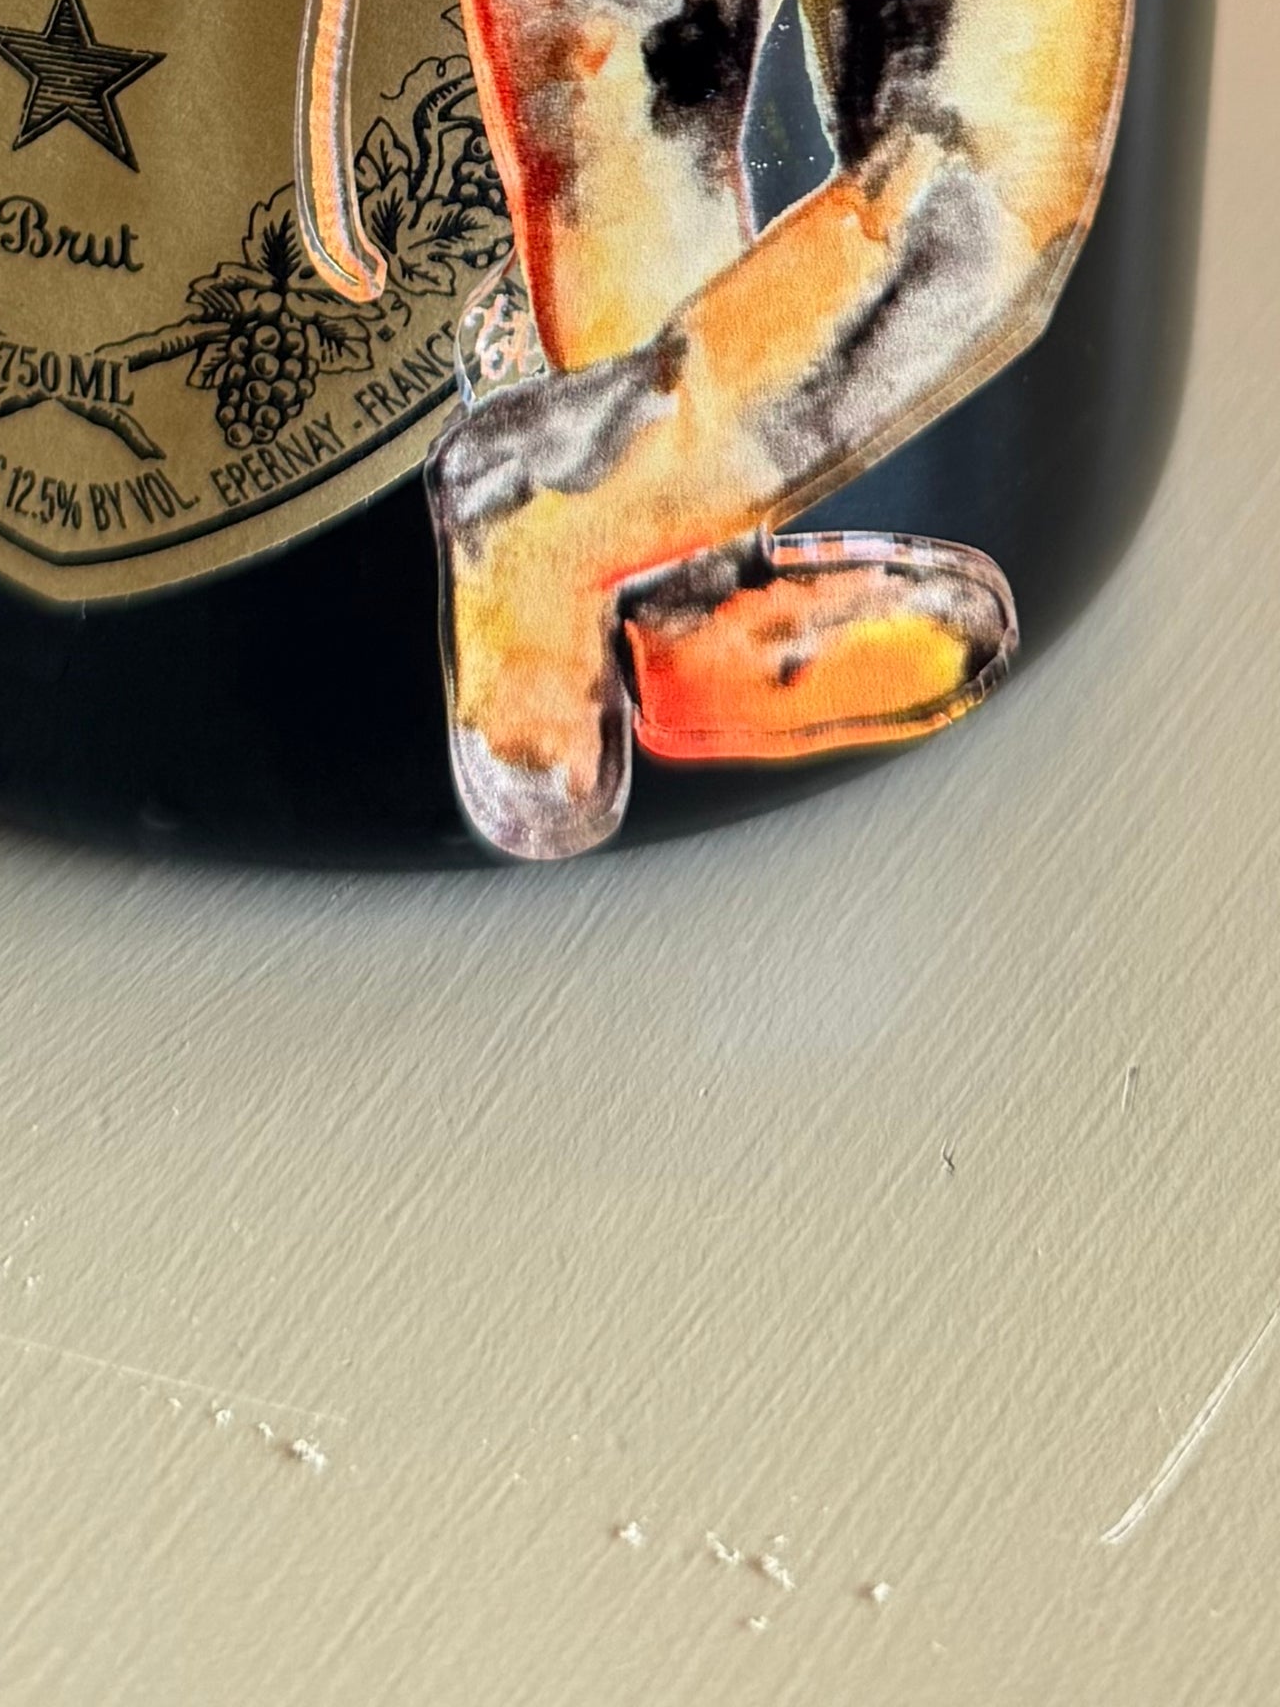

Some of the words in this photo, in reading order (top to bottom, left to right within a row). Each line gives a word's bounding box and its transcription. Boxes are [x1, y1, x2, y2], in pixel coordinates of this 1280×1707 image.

[88, 480, 127, 532] BY
[125, 467, 201, 524] VOL.
[210, 410, 344, 508] EPERNAY
